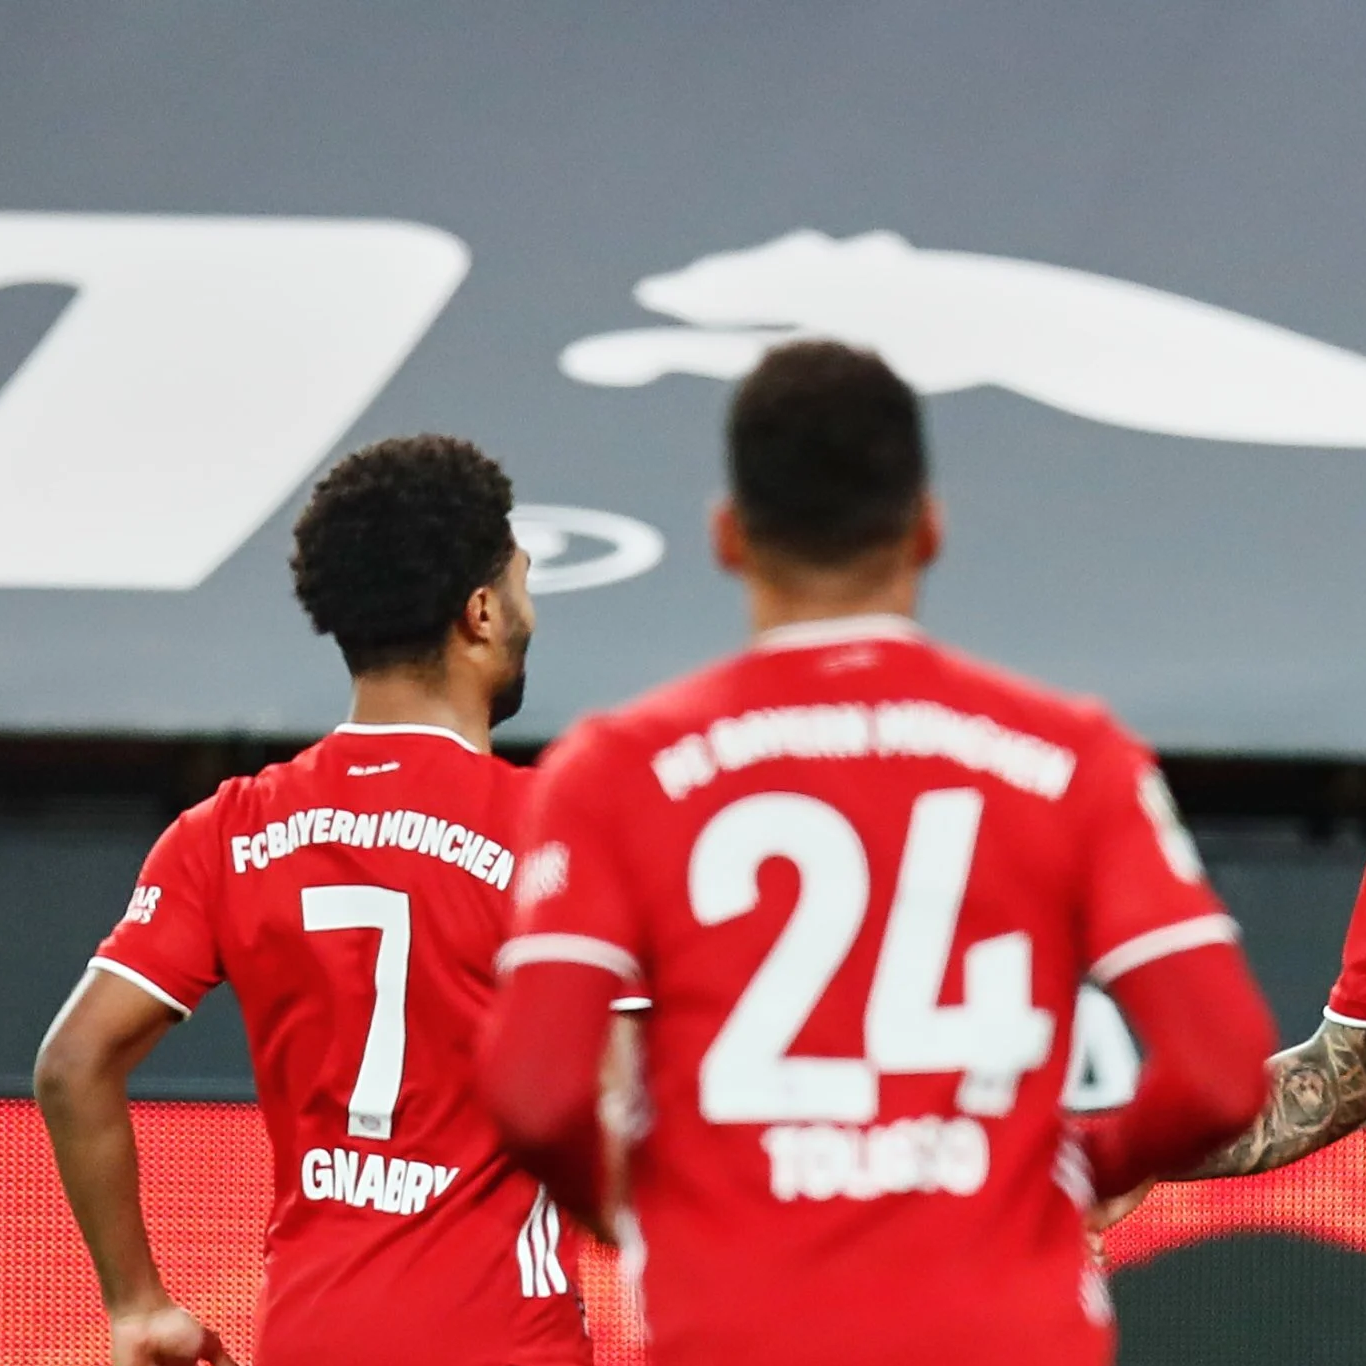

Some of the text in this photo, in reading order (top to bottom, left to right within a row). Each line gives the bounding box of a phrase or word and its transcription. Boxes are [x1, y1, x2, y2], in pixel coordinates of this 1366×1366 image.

[231, 832, 269, 873] FC
[265, 808, 378, 859] BAYERN
[301, 884, 411, 1139] 7
[688, 790, 1055, 1125] 24
[301, 1147, 461, 1215] GNABRY
